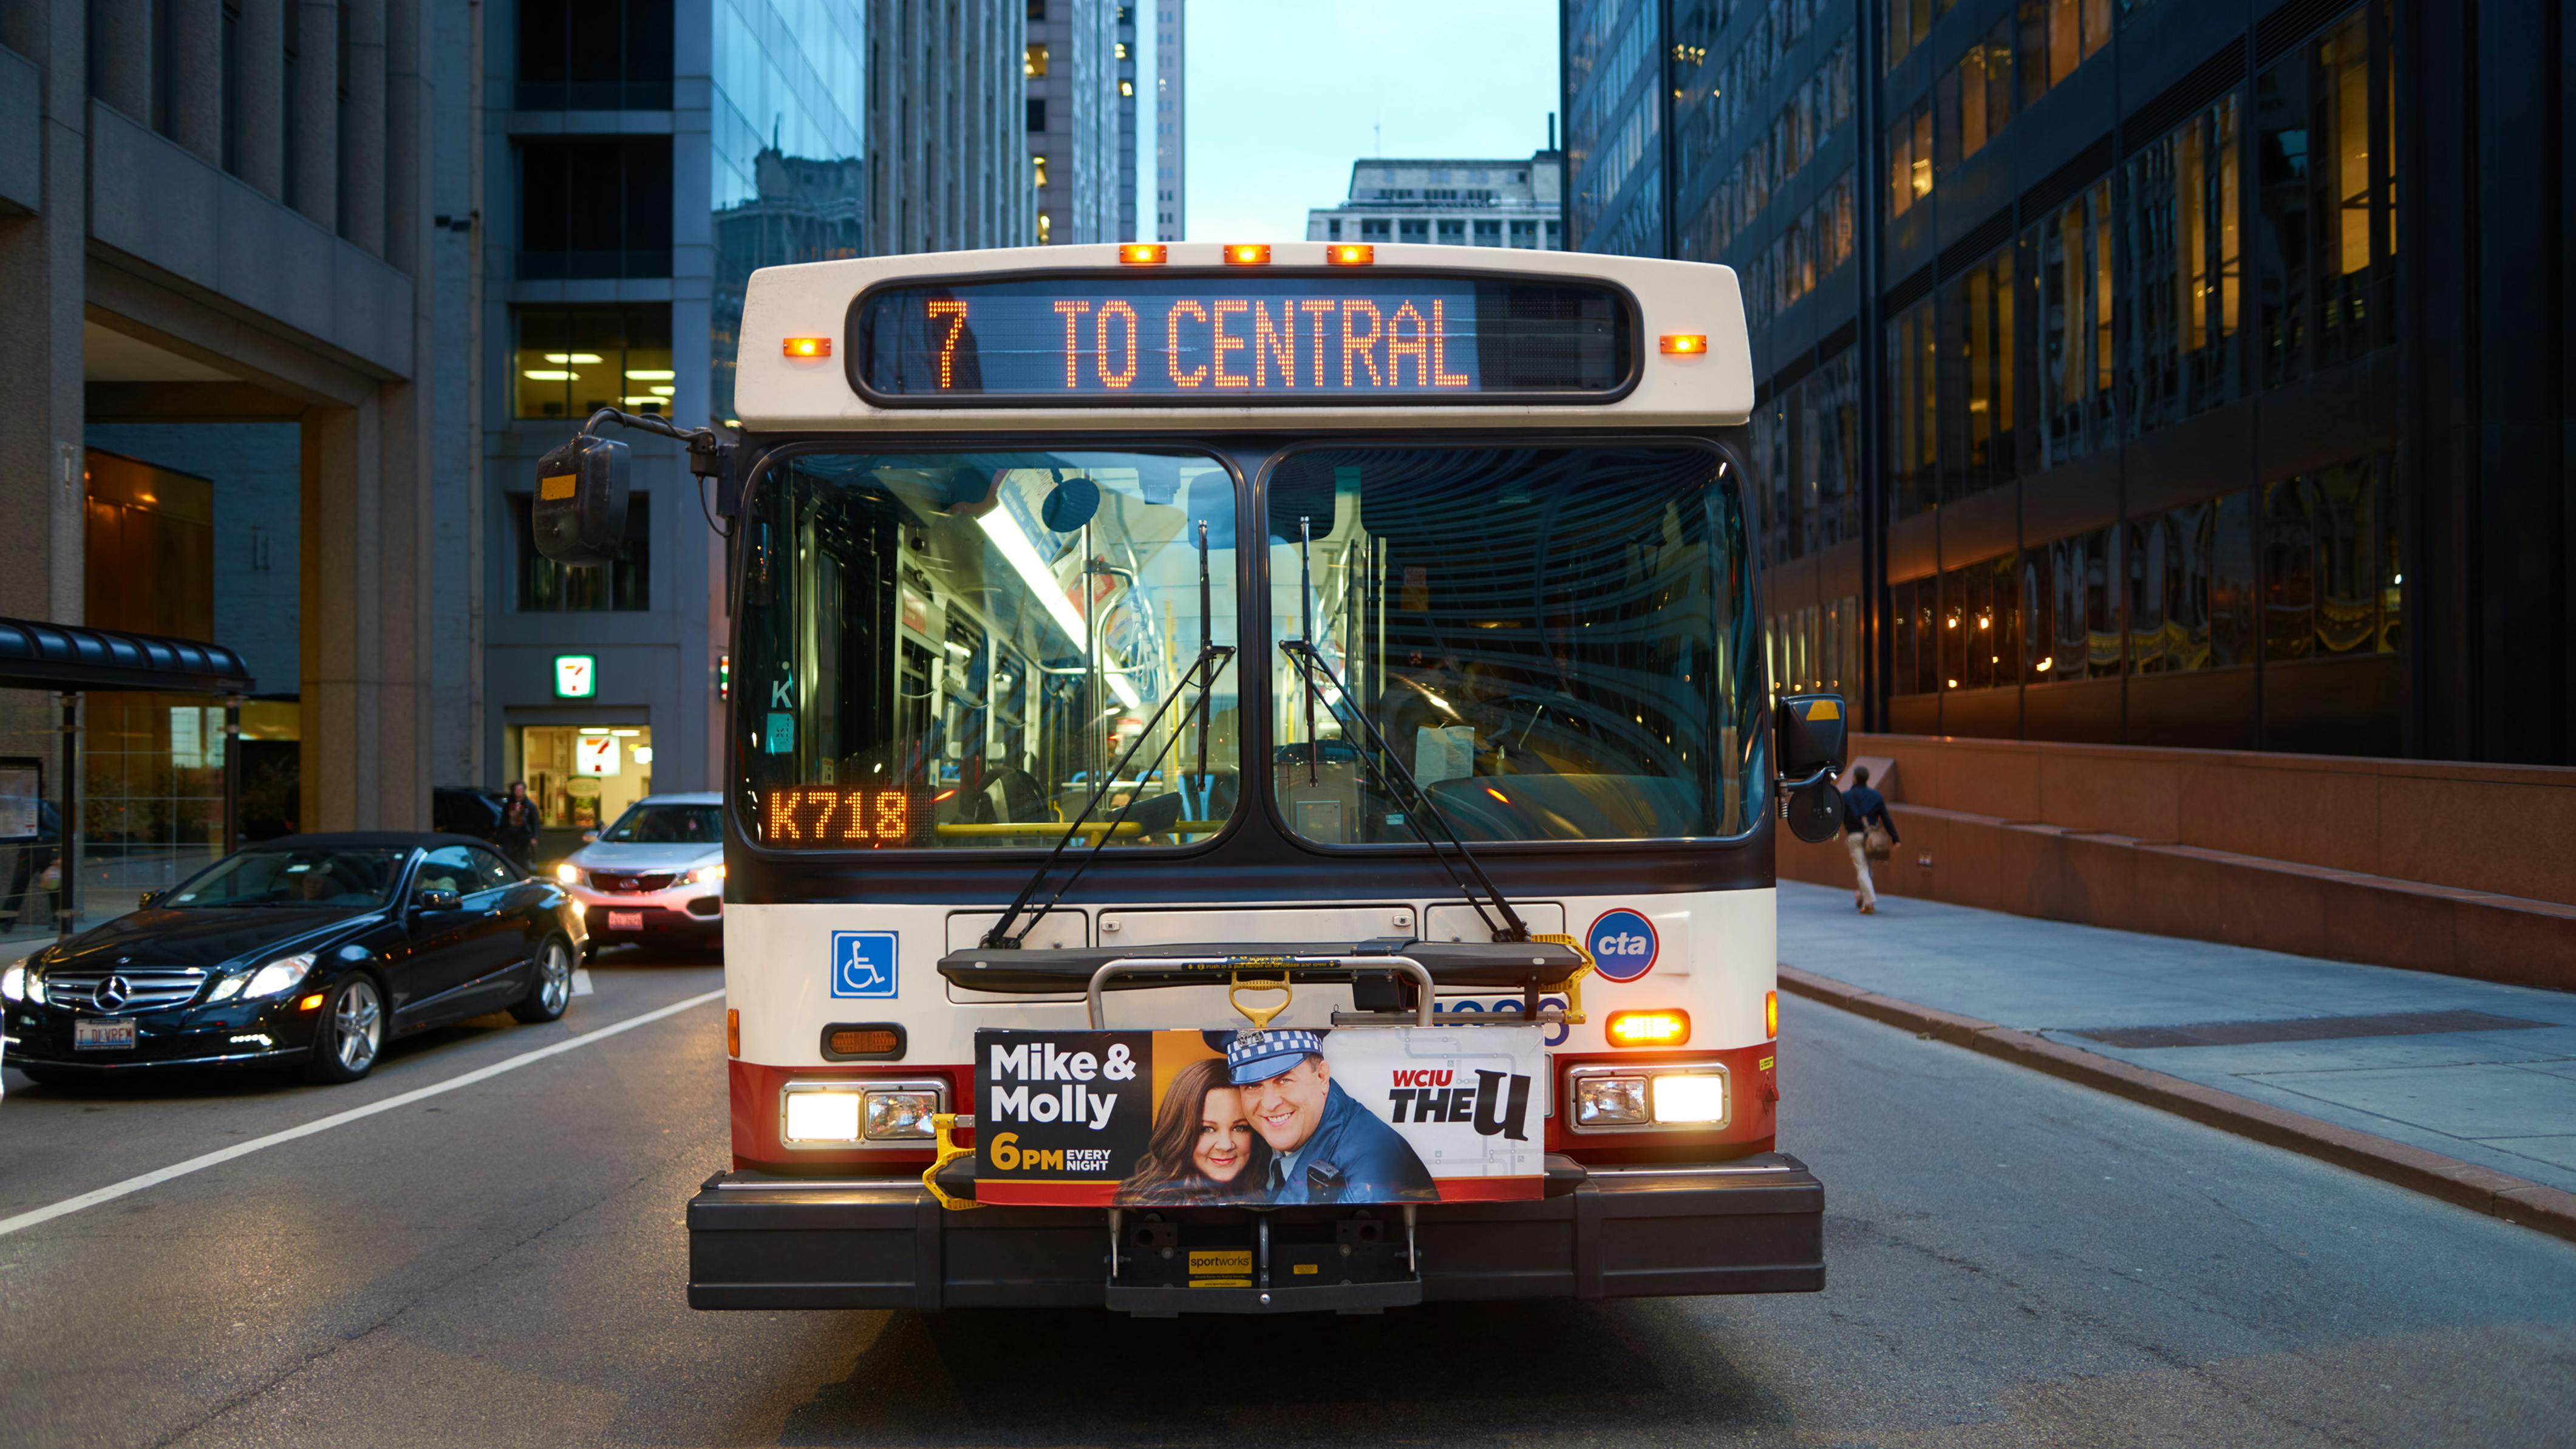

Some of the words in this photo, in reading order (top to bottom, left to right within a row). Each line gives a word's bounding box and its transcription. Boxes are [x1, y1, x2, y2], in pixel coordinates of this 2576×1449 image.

[929, 301, 967, 389] 7
[1054, 301, 1136, 388] TO
[1168, 299, 1468, 388] CENTRAL
[771, 680, 792, 708] K
[771, 791, 906, 839] K718
[1598, 932, 1647, 955] cta
[991, 1043, 1098, 1081] Mike
[1103, 1043, 1136, 1081] &
[1392, 1069, 1453, 1088] WCIU
[991, 1084, 1118, 1130] Molly
[1389, 1088, 1477, 1123] THE
[1066, 1150, 1111, 1160] EVERY
[1066, 1160, 1108, 1171] NIGHT
[1190, 1256, 1250, 1268] sportworks
